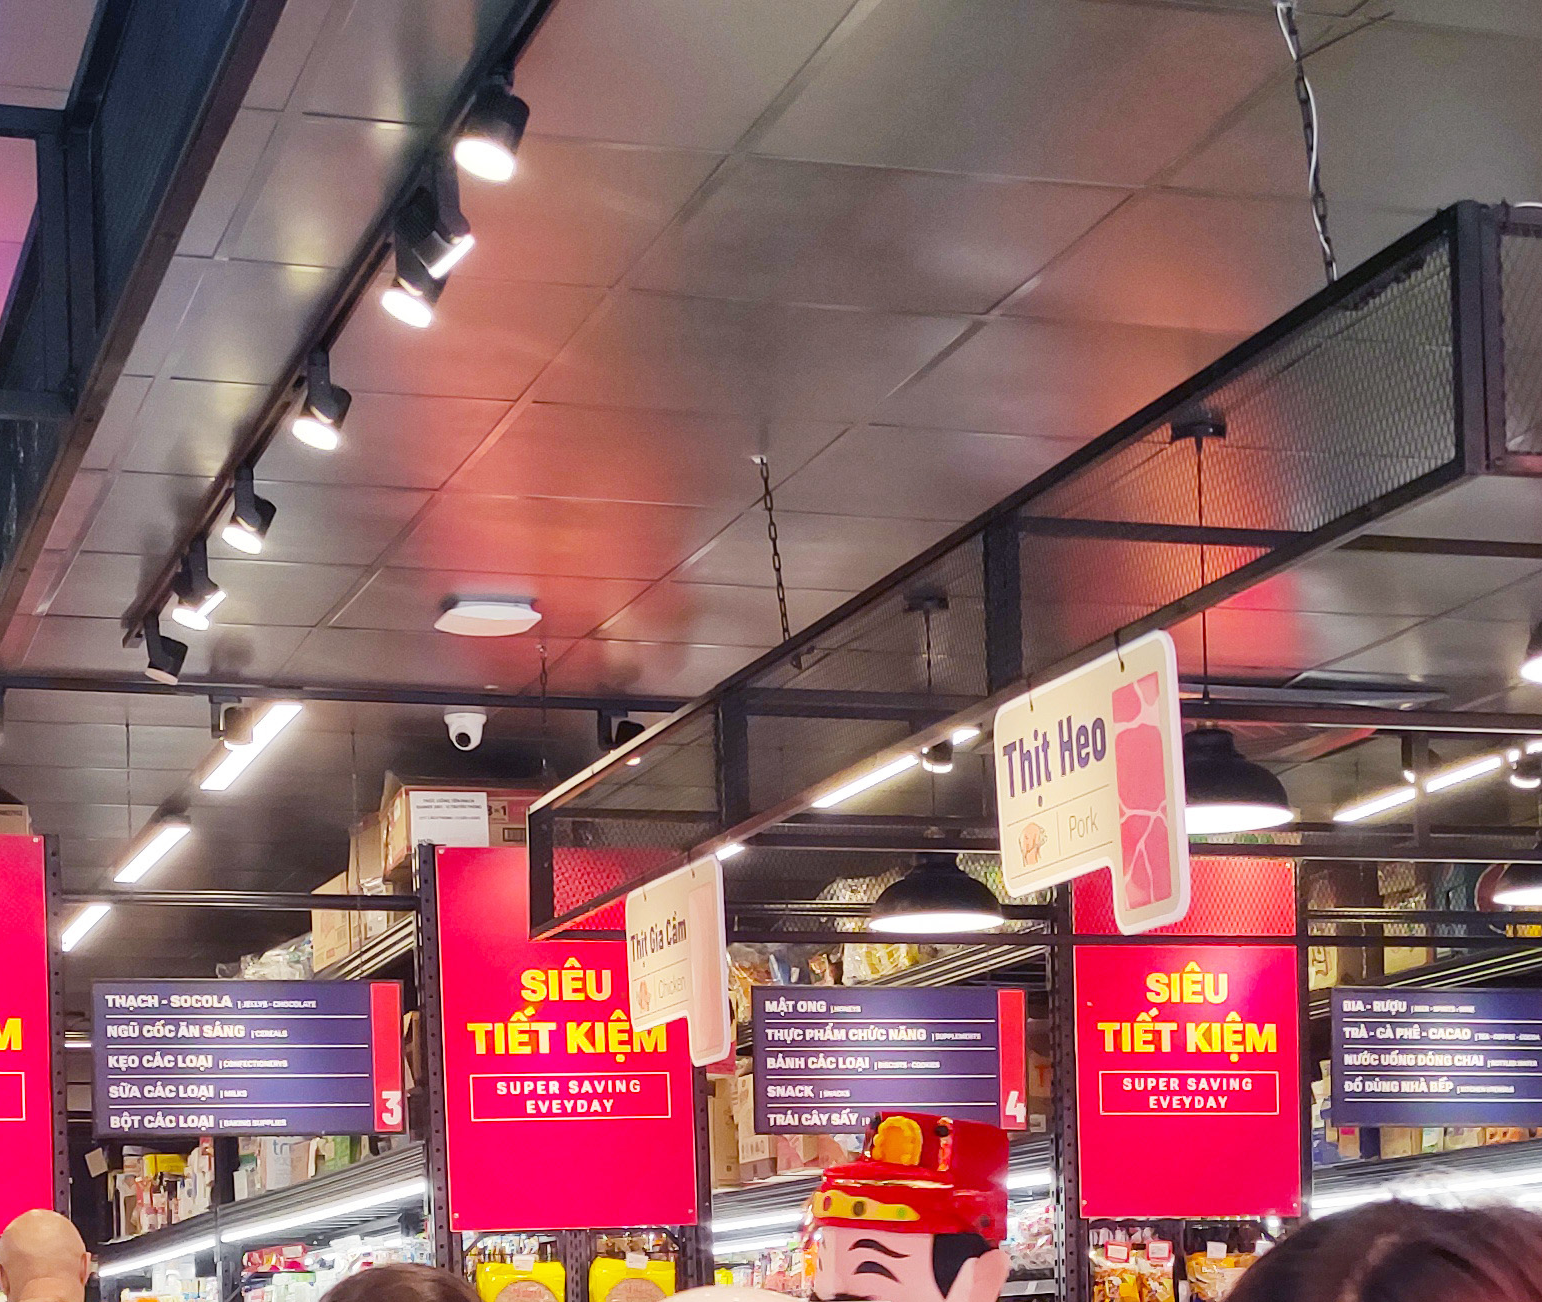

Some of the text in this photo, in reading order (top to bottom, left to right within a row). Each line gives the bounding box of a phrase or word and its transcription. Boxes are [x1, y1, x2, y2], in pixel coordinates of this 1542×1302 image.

[1003, 715, 1106, 807] Thịt Heo
[1068, 810, 1099, 839] Pork
[631, 911, 687, 967] Thịt Gia Cầm
[520, 957, 612, 1002] SIÊU
[1145, 961, 1229, 1004] SIÊU
[105, 995, 233, 1011] THẠCH SOCOLA
[765, 997, 827, 1016] MẬT ONG
[106, 1022, 139, 1038] NGŨ
[142, 1019, 176, 1038] CỐC
[202, 1021, 246, 1038] SÁNG
[467, 1006, 668, 1063] TIẾT KIỆM
[765, 1022, 927, 1043] THỰC PHẨM CHỨC NĂNG
[1097, 1007, 1277, 1063] TIẾT KIỆM
[1428, 1027, 1472, 1040] CACAO
[108, 1051, 213, 1071] KẸO CÁC LOẠI
[766, 1053, 870, 1072] BÁNH CÁC LOẠI
[1454, 1054, 1484, 1066] CHAI
[109, 1081, 214, 1101] SỮA CÁC LOẠI
[496, 1079, 641, 1095] SUPER SAVING
[767, 1085, 814, 1098] SNACK
[1122, 1078, 1253, 1091] SUPER SAVING
[381, 1090, 402, 1125] 3
[526, 1099, 614, 1114] EVEYDAY
[1005, 1090, 1027, 1123] 4
[1149, 1095, 1228, 1109] EVEYDAY
[110, 1111, 215, 1131] BỘT CÁC LOẠI
[767, 1108, 859, 1126] TRÁI CÂY SẤY
